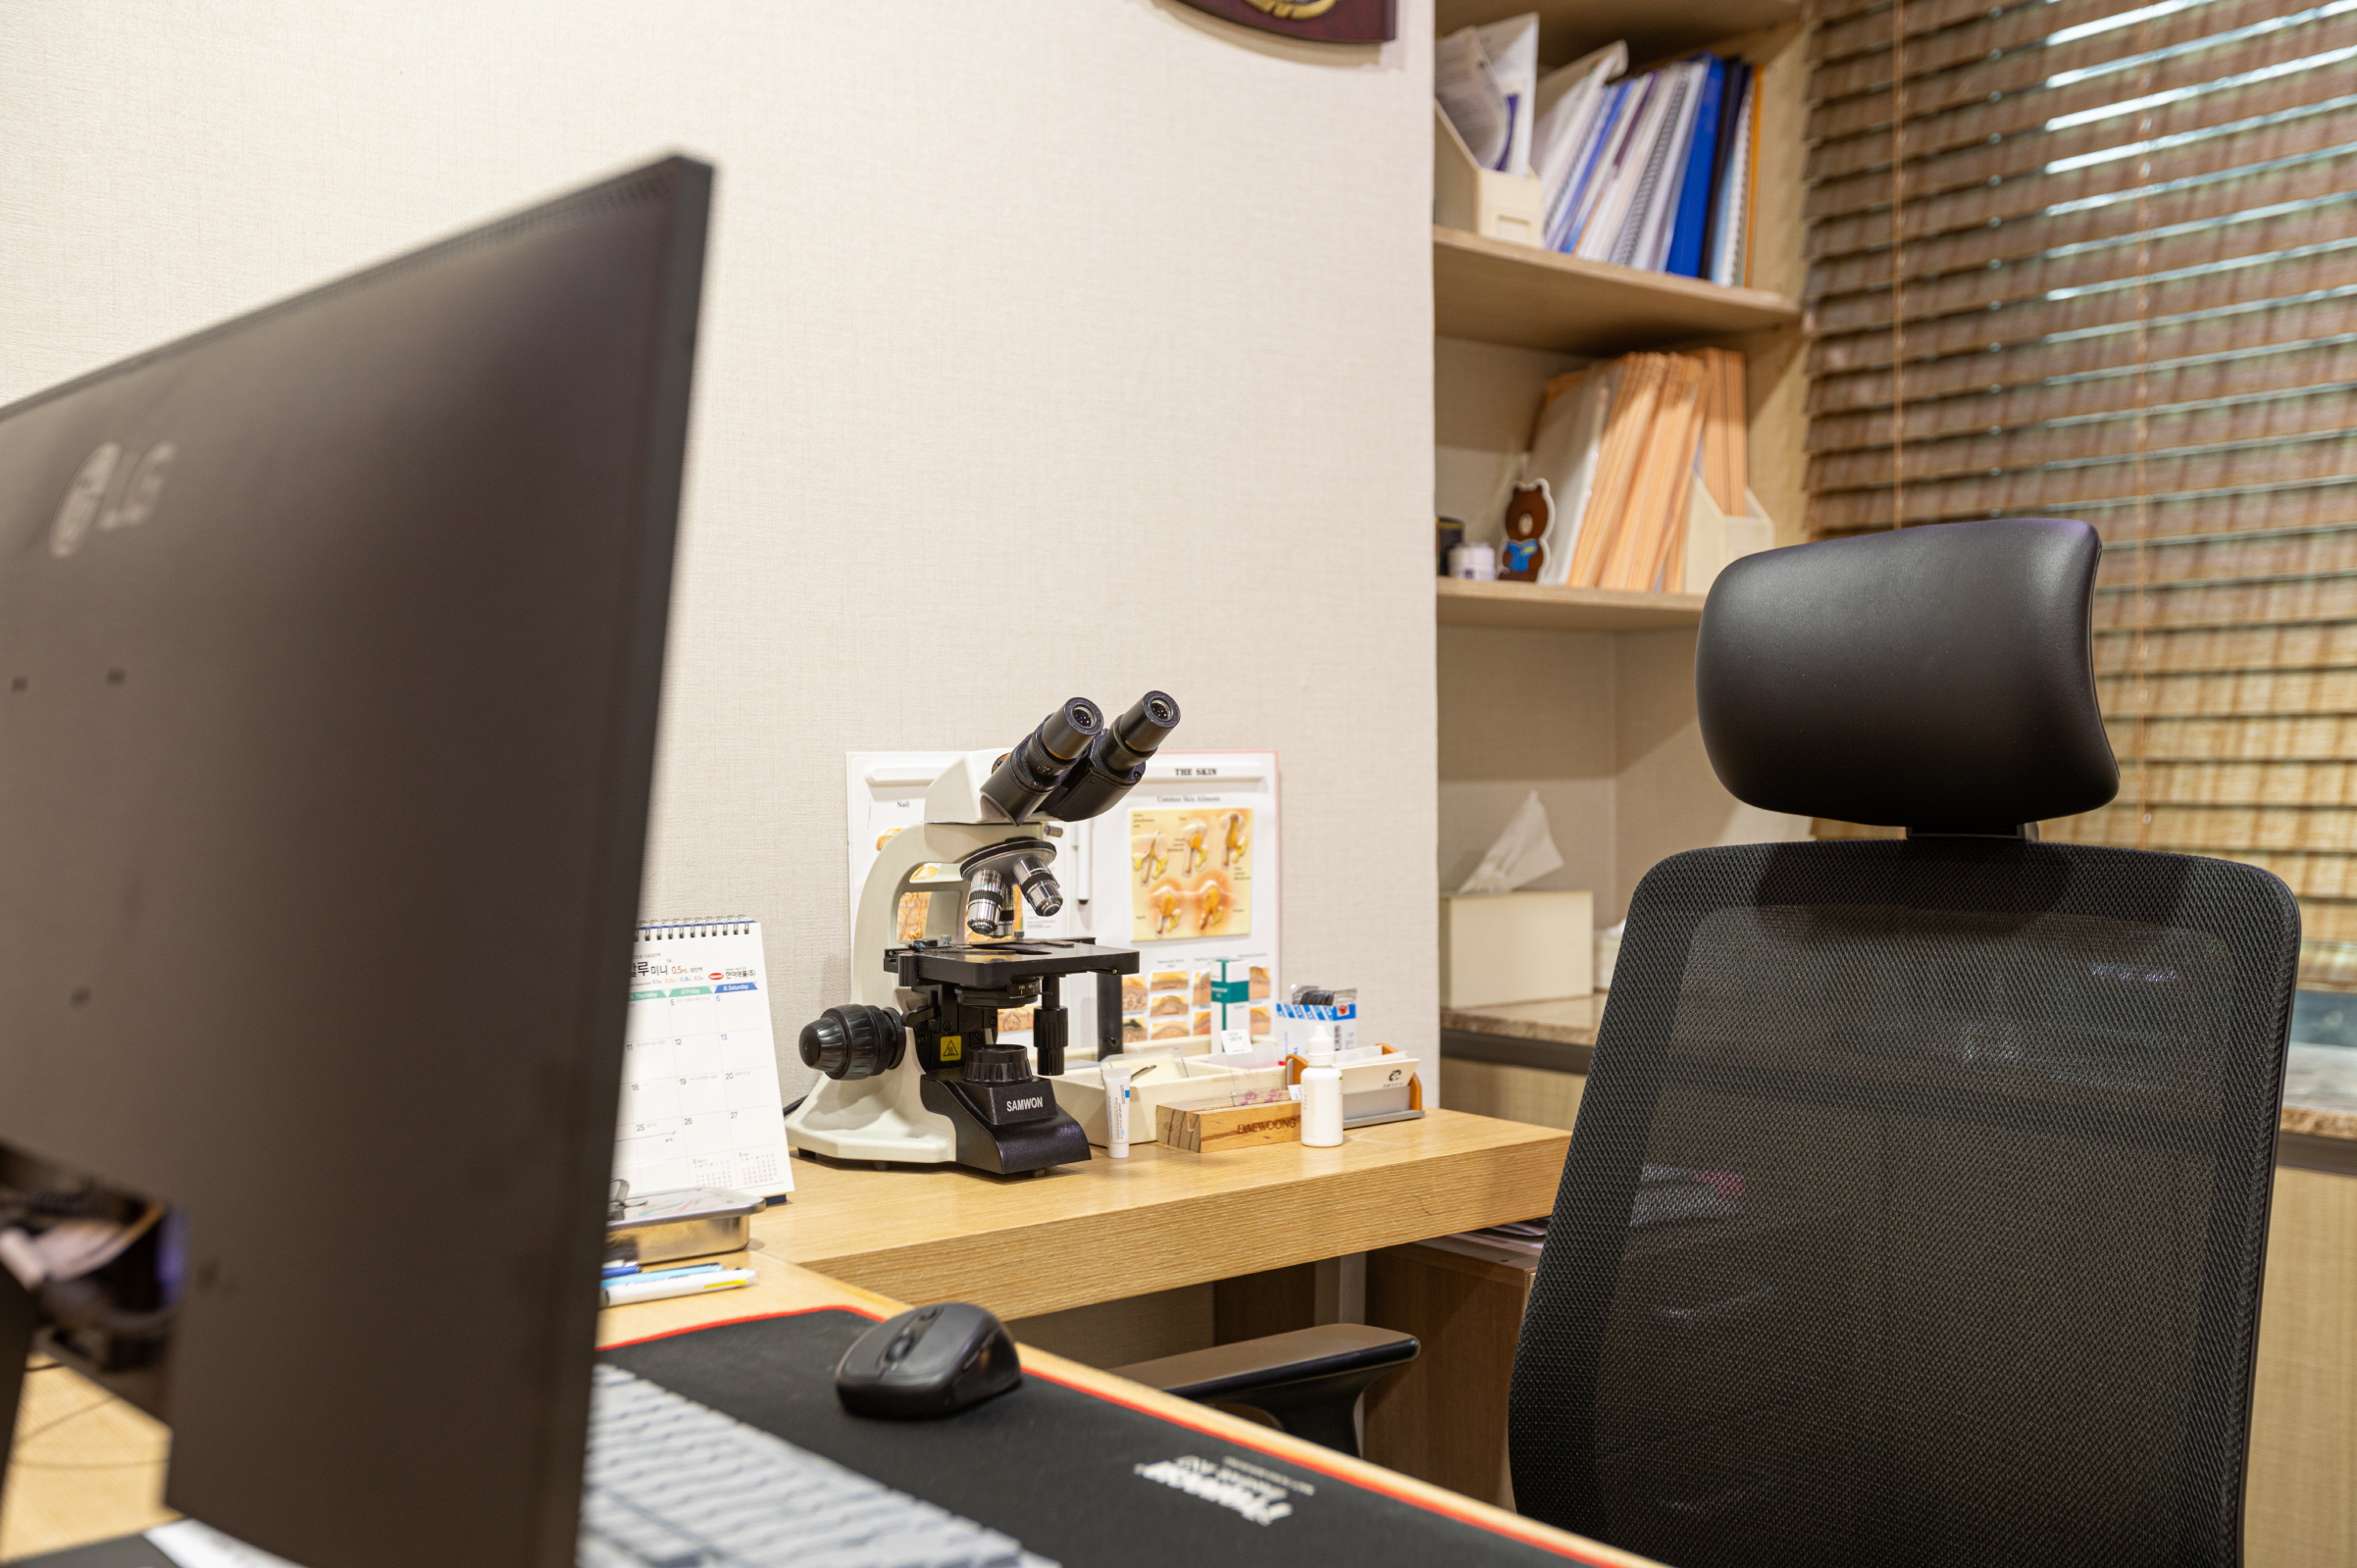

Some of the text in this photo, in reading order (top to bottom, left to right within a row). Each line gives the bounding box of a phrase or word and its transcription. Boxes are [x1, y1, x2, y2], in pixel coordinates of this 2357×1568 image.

[728, 984, 748, 992] Saturday
[1006, 1096, 1044, 1112] SAMWON
[1237, 1118, 1297, 1135] DAEWOONG
